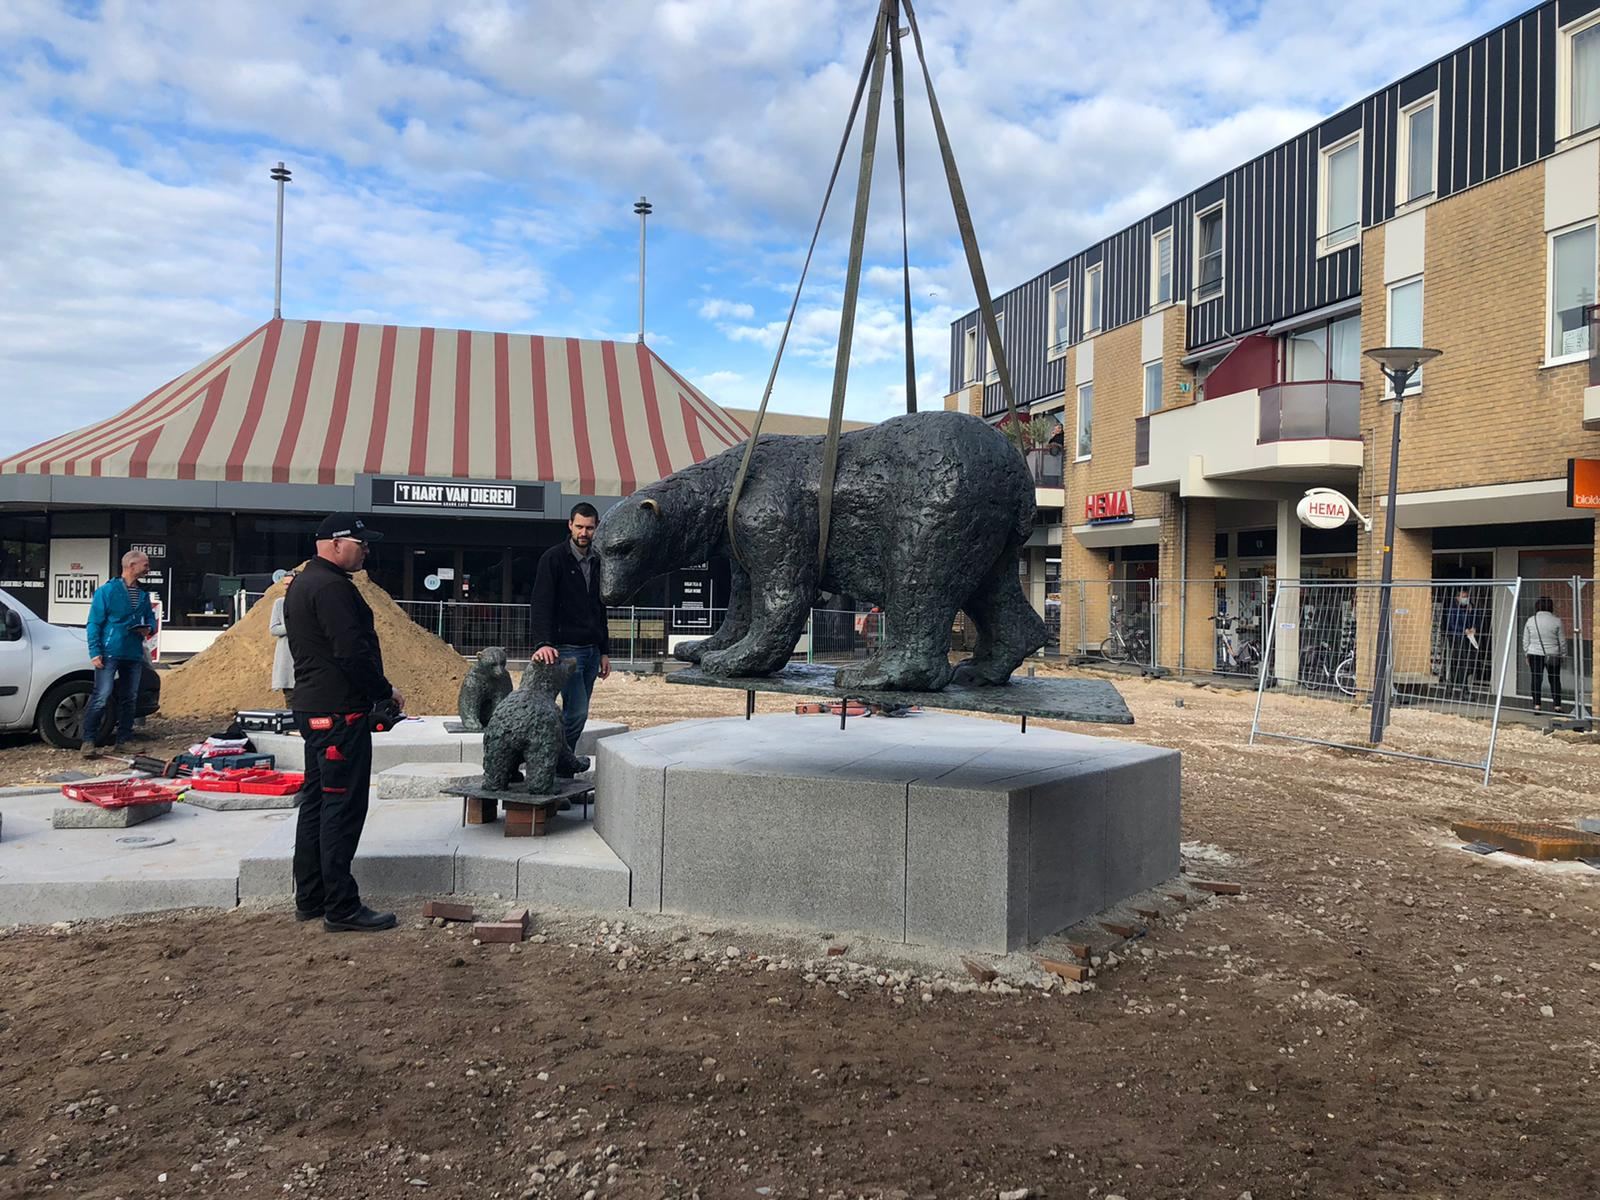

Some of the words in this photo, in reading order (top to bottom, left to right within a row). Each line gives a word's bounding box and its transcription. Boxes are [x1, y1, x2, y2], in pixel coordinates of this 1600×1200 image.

[412, 485, 443, 502] HART
[446, 487, 469, 503] VAN
[471, 488, 512, 504] DIEREN
[1085, 490, 1133, 519] HEMA
[1309, 502, 1345, 517] HEMA
[57, 579, 96, 598] DIEREN
